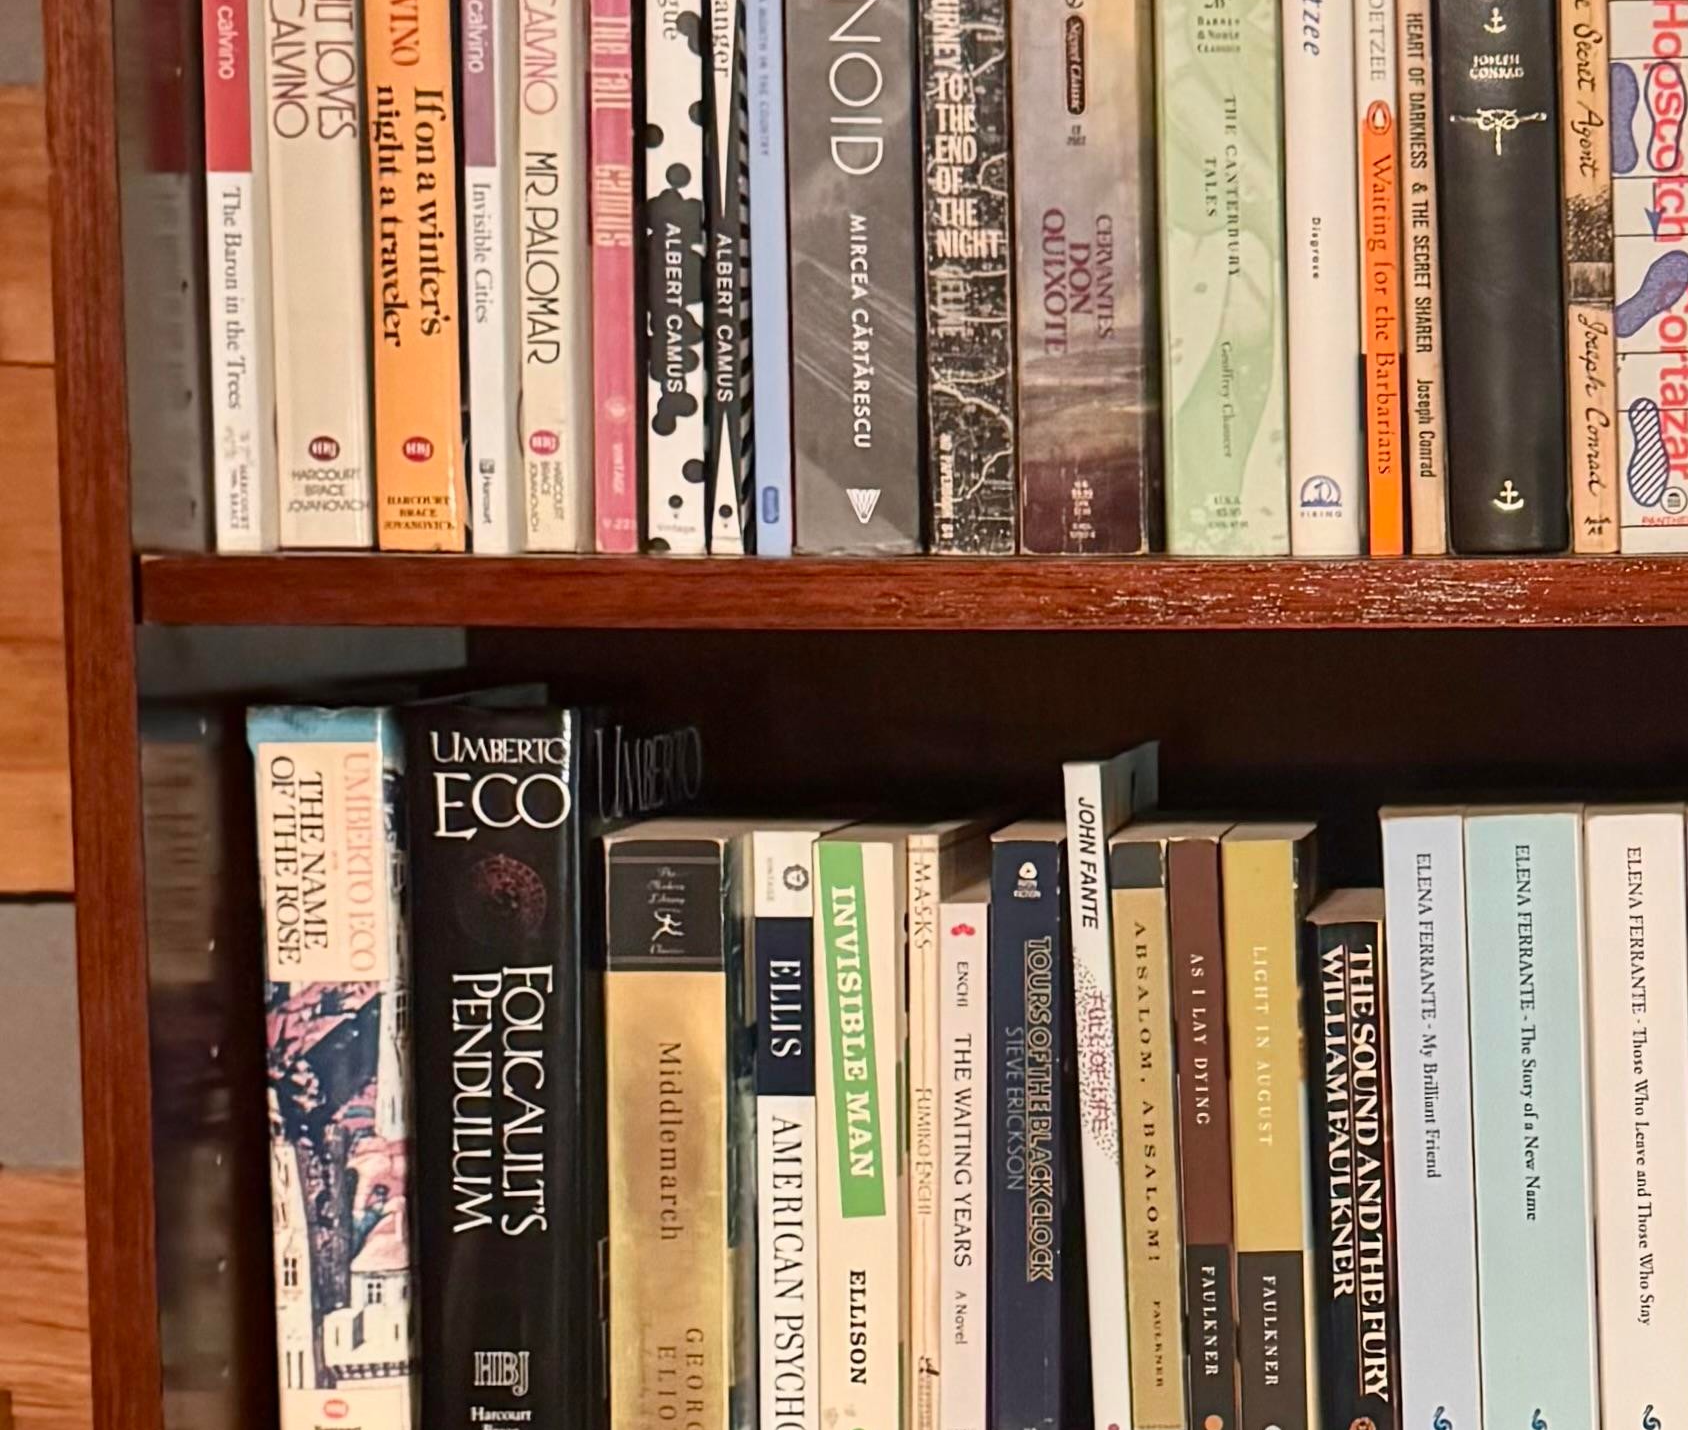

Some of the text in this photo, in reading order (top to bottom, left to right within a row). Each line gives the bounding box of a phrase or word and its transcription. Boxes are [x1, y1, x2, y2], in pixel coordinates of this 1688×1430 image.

[315, 37, 356, 140] LOVES
[664, 223, 682, 393] ALBERT CAMUS
[848, 212, 872, 449] MIRCEA CĂRTĂRESCU
[1311, 217, 1321, 279] Disgrace
[429, 732, 570, 764] UMBERTO
[432, 773, 572, 841] ECO
[271, 756, 301, 964] OF THE ROSE
[300, 772, 327, 949] THE NAME
[1078, 797, 1100, 929] JOHN FANTE
[1419, 853, 1436, 1022] ELENA FERRANTE
[770, 958, 802, 1058] ELLIS
[829, 886, 875, 1177] INVISIBLE MAN
[451, 973, 502, 1235] PENDULUM
[500, 965, 553, 1237] FOUCAULT'S
[659, 1041, 682, 1242] Middlemarch
[772, 1115, 805, 1301] AMERICAN
[848, 1270, 866, 1386] ELLISON
[1200, 1266, 1219, 1377] FAULKNER
[1263, 1275, 1279, 1387] FAULKNER
